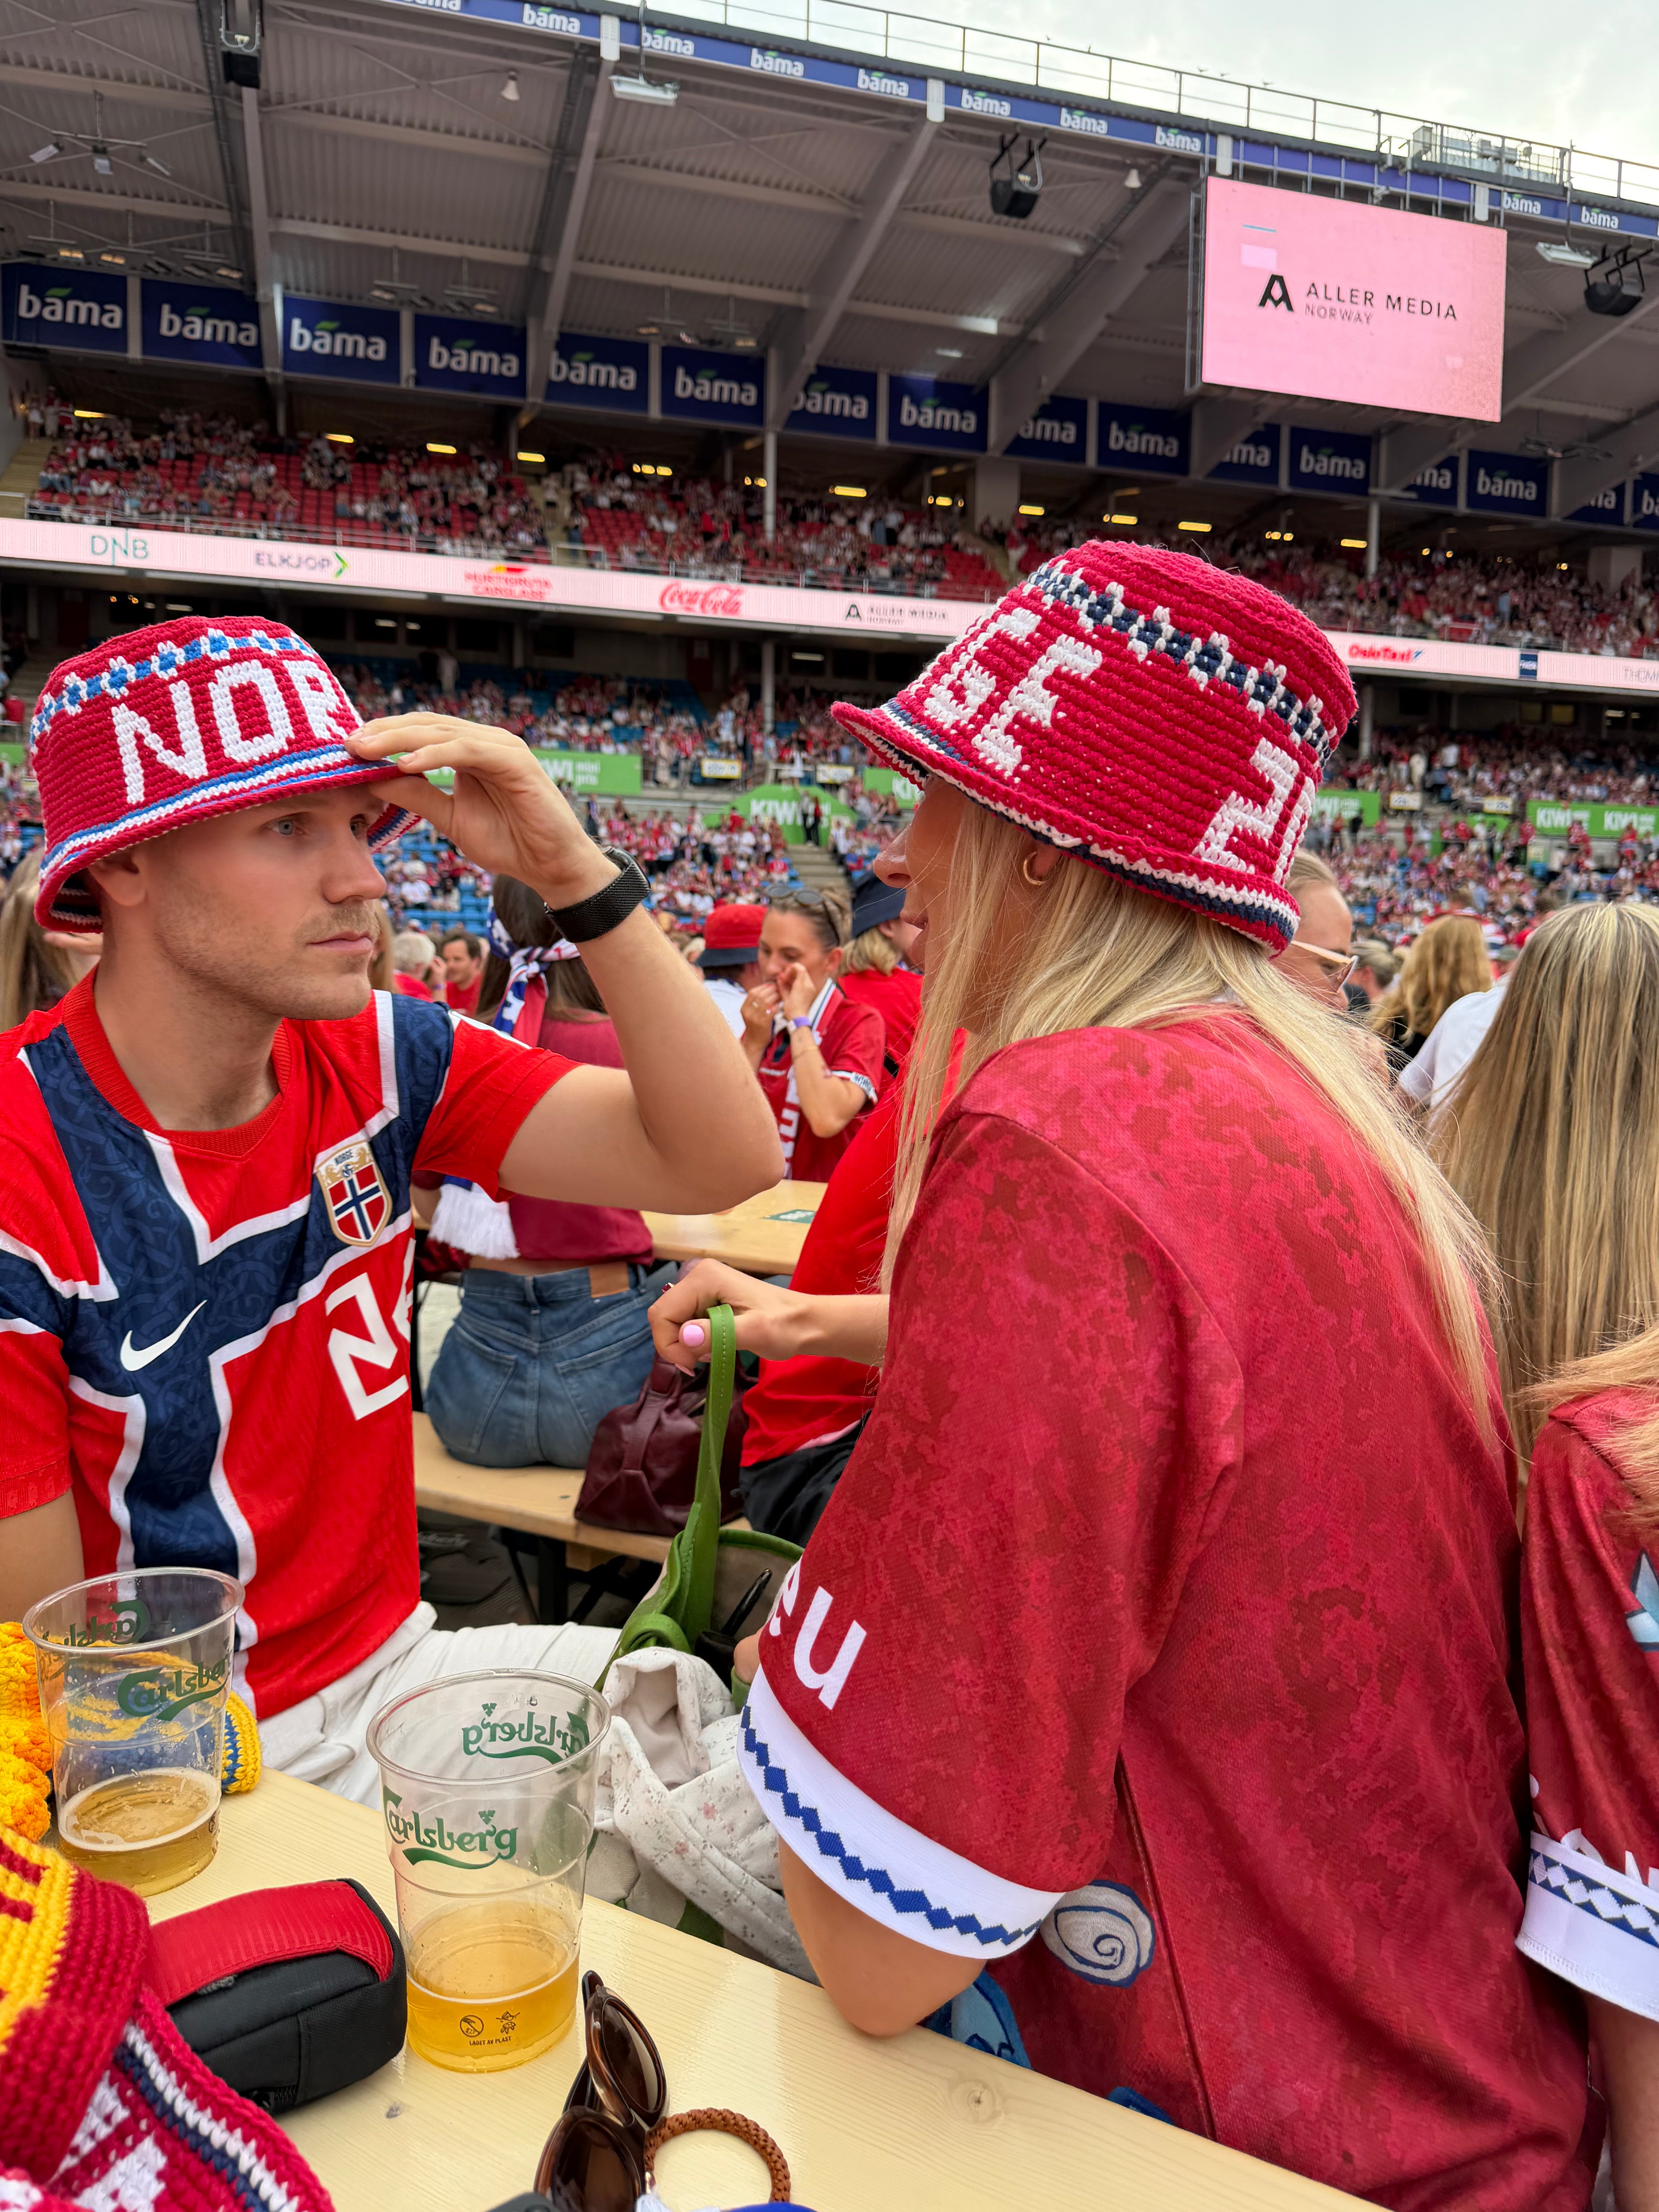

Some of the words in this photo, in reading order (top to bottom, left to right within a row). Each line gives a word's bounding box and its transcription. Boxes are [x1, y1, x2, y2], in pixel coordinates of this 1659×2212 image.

[18, 284, 124, 329] bama
[1304, 303, 1373, 326] NORWAY
[1306, 282, 1375, 308] ALLER
[1385, 294, 1458, 321] MEDIA
[159, 303, 259, 346] bama
[289, 318, 387, 361] bama
[429, 337, 520, 378] bama
[674, 365, 758, 407] bama
[900, 395, 977, 433] bama
[1018, 417, 1077, 444] ama
[1109, 421, 1179, 458] bama
[1220, 442, 1271, 467] ma
[1300, 444, 1366, 480] bama
[91, 528, 149, 566] DNB
[111, 659, 365, 805] NOR
[383, 1784, 518, 1860] Carlsberg
[495, 2036, 512, 2044] PLAST
